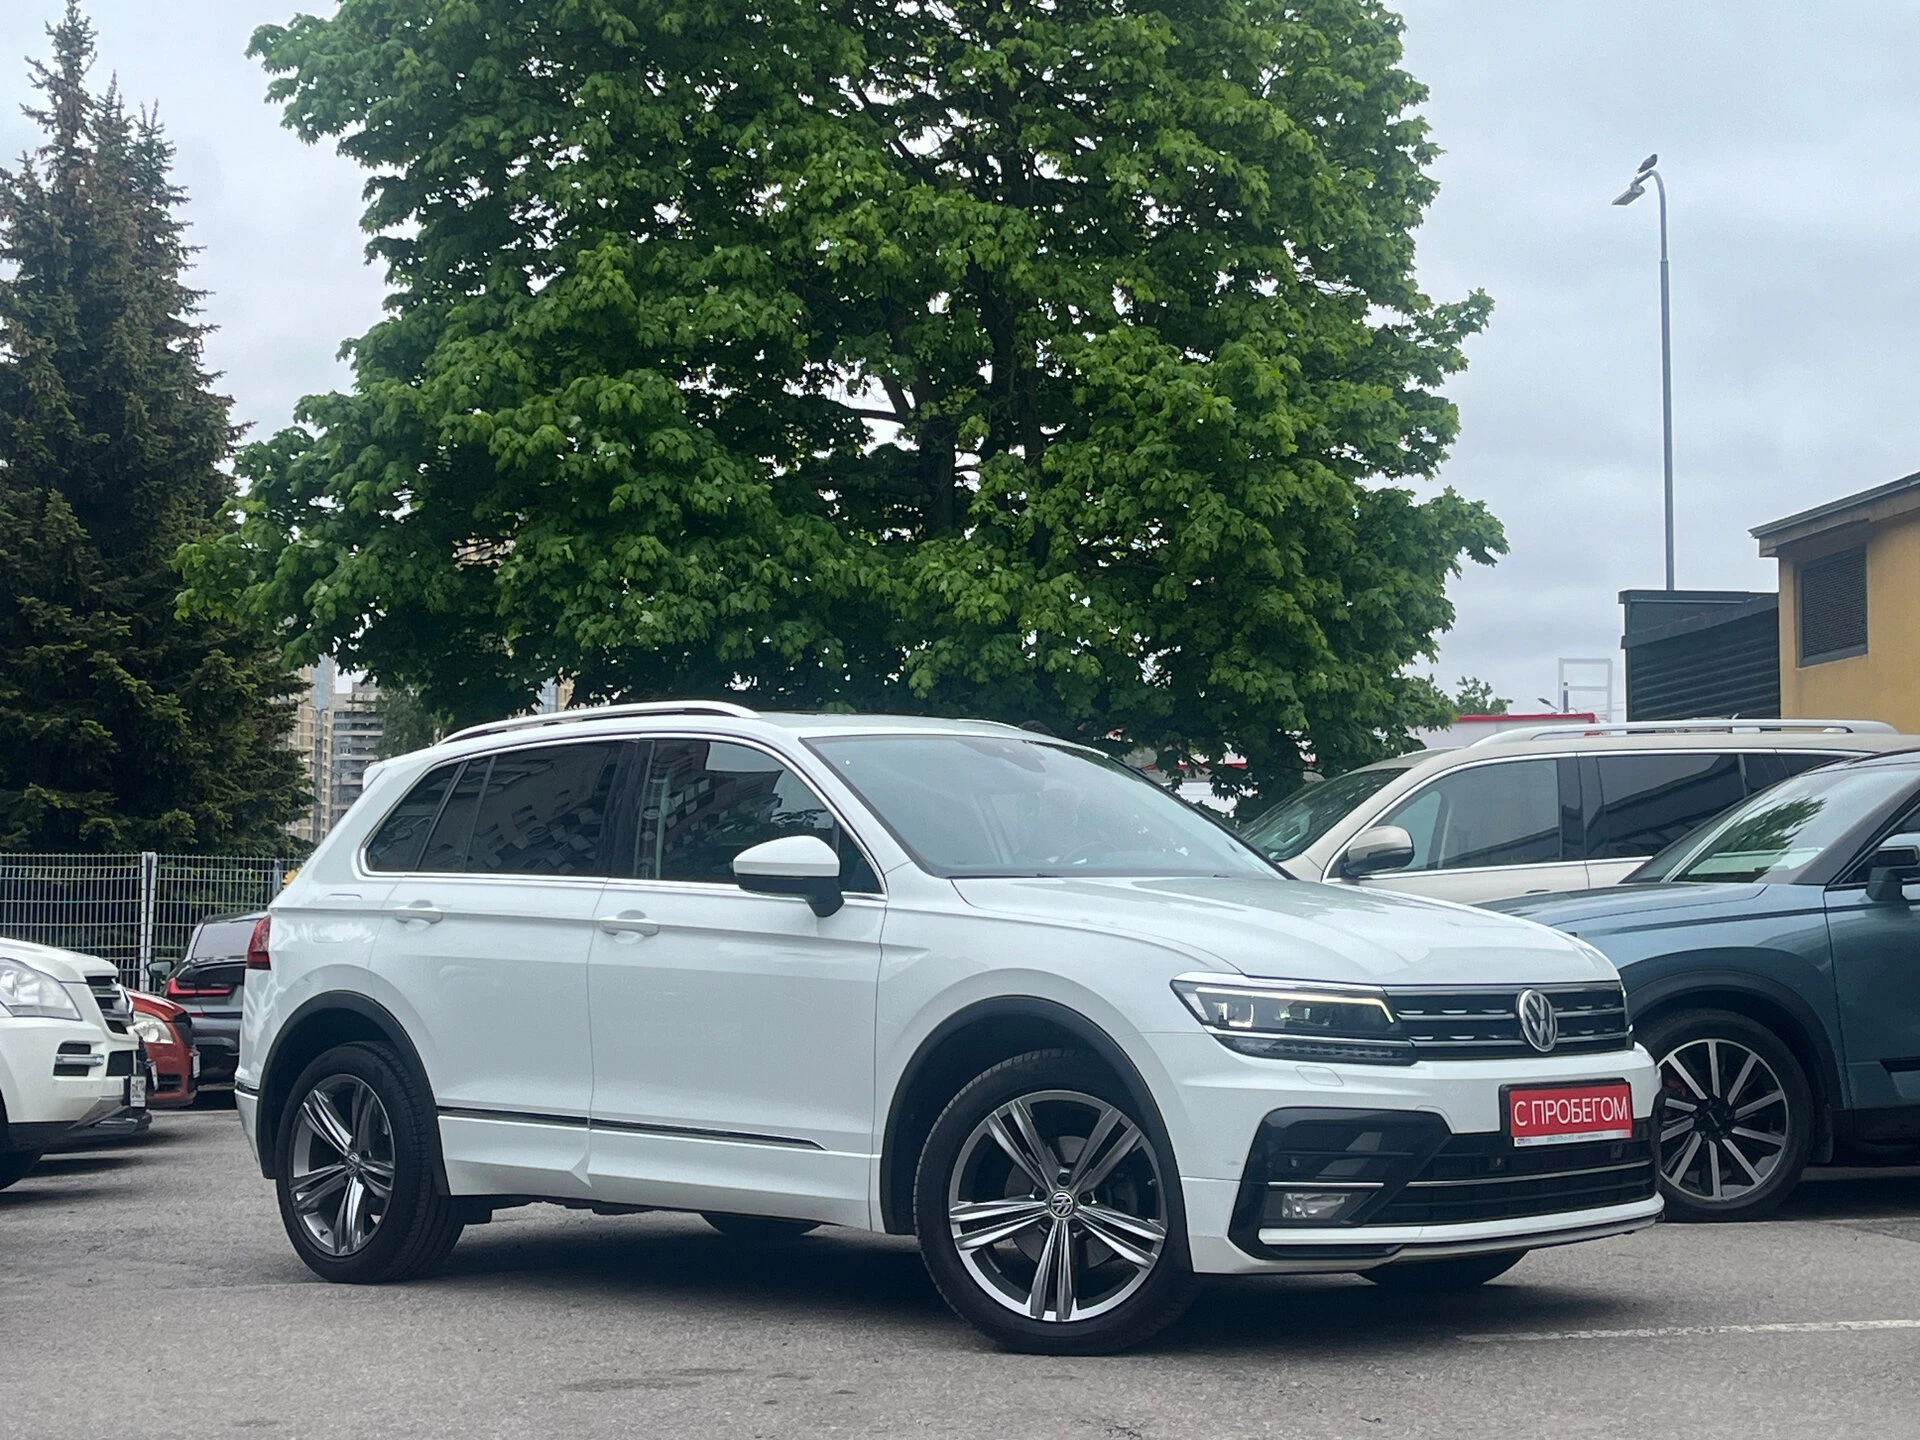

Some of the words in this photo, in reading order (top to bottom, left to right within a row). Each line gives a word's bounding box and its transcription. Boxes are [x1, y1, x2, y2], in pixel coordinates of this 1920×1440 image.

[1519, 989, 1557, 1052] VW
[1514, 1101, 1528, 1126] С
[1531, 1096, 1628, 1125] ПРОБЕГОМ
